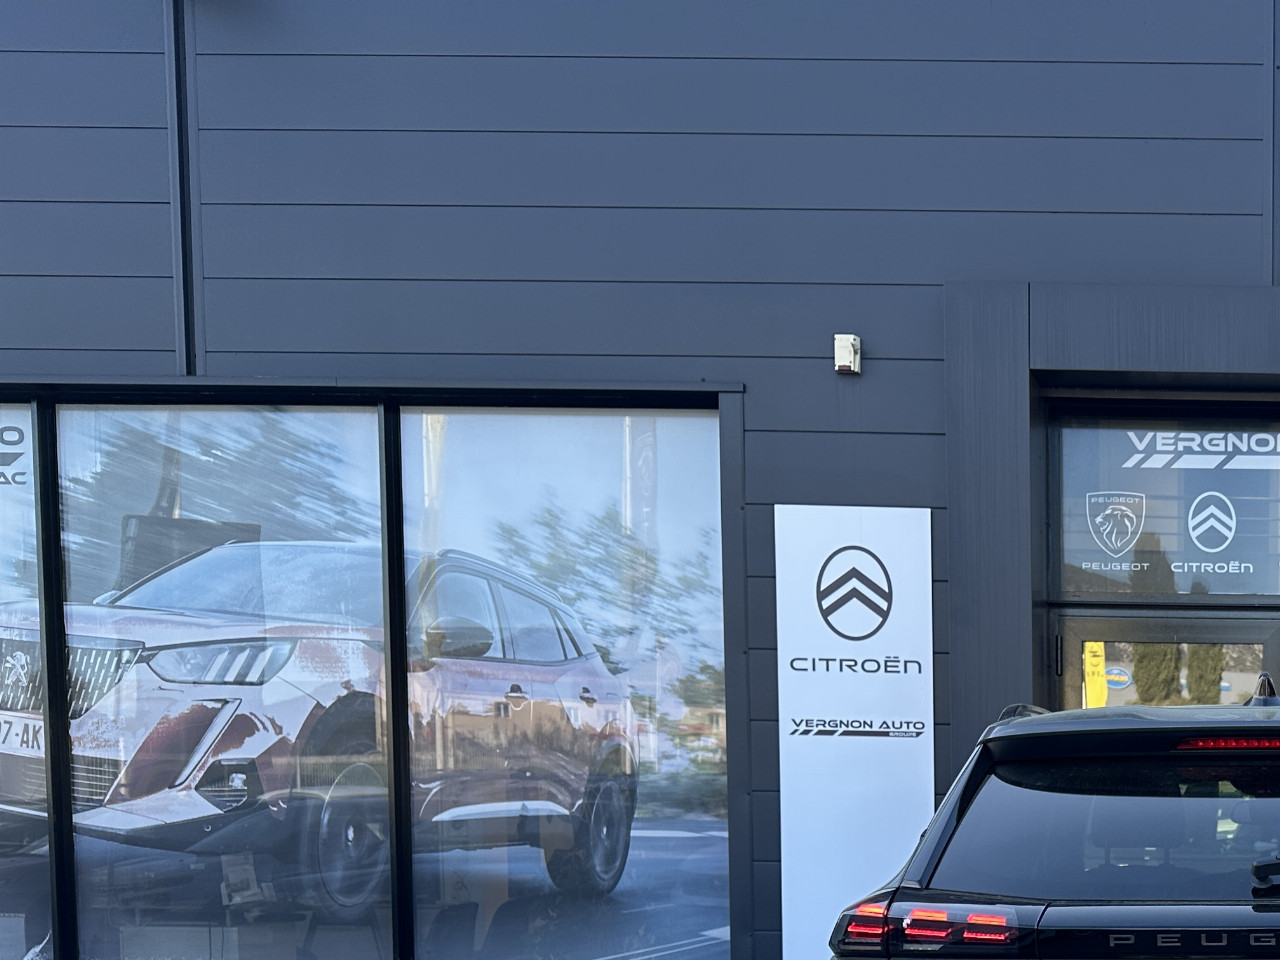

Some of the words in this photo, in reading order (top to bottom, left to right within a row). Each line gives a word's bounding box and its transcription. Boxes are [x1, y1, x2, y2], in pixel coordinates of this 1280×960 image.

[1091, 496, 1141, 504] PEUGEOT
[1081, 562, 1150, 571] PEUGEOT
[1170, 560, 1254, 573] CITROËN
[790, 656, 922, 674] CITROËN
[791, 718, 873, 729] VERGNON
[878, 720, 925, 730] AUTO
[0, 720, 42, 750] 7-AK
